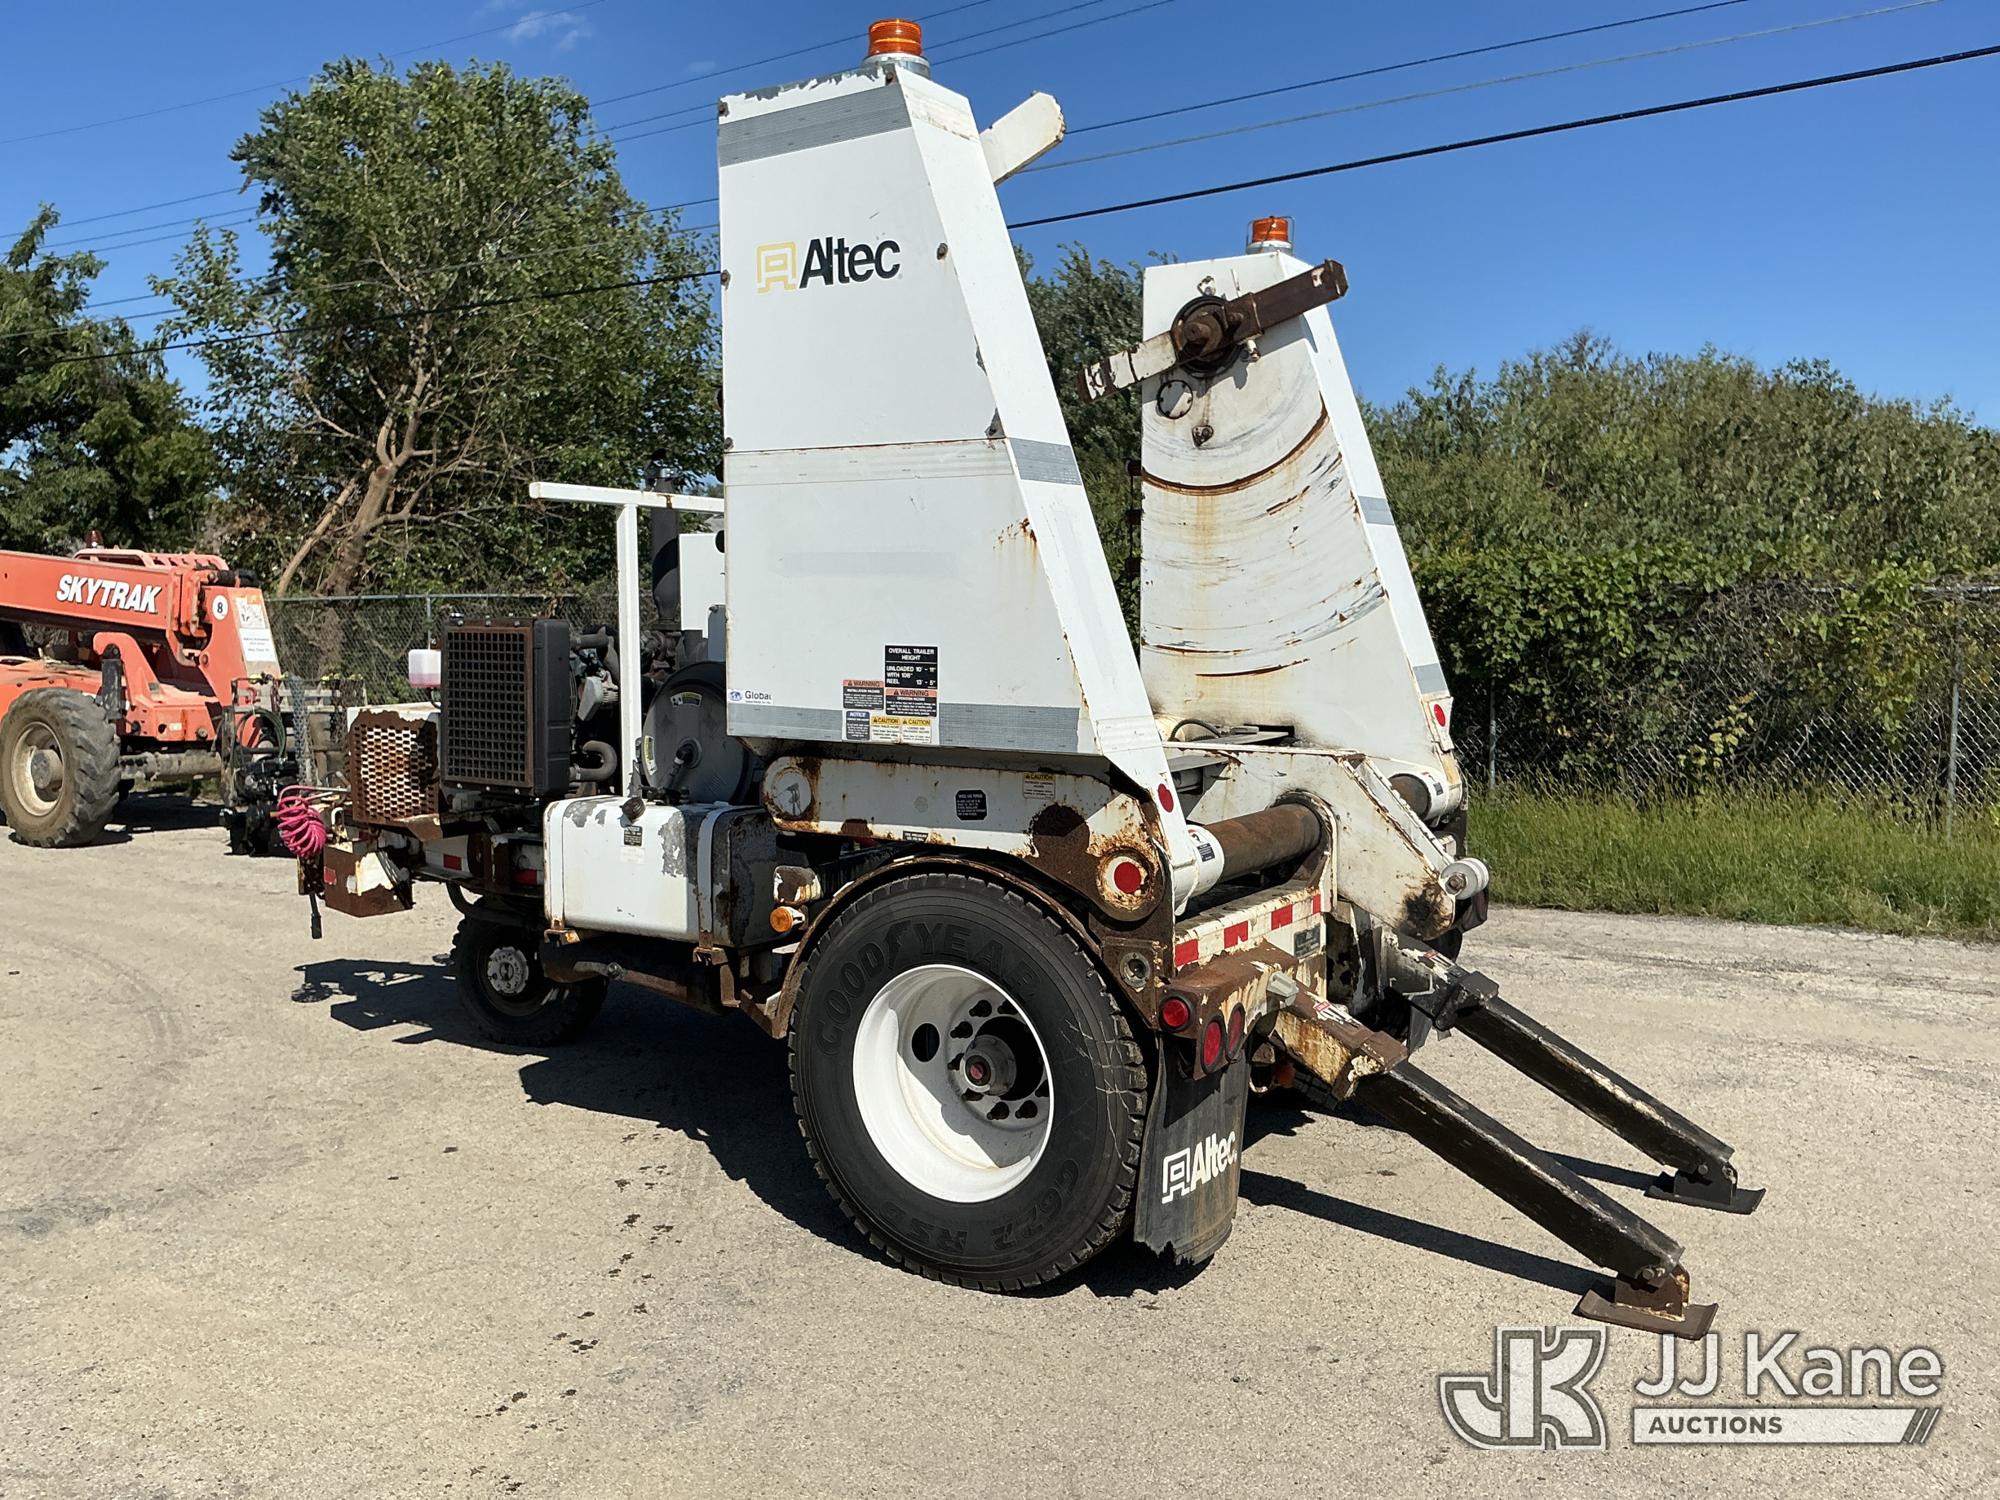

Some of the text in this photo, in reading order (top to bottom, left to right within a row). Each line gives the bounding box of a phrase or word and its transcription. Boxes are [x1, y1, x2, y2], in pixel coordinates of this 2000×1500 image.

[799, 236, 901, 289] Altec
[56, 573, 162, 615] SKYTRAK
[216, 601, 224, 614] 8
[853, 680, 880, 688] WARNING
[900, 689, 929, 697] WARNING
[1190, 1130, 1237, 1192] Altec
